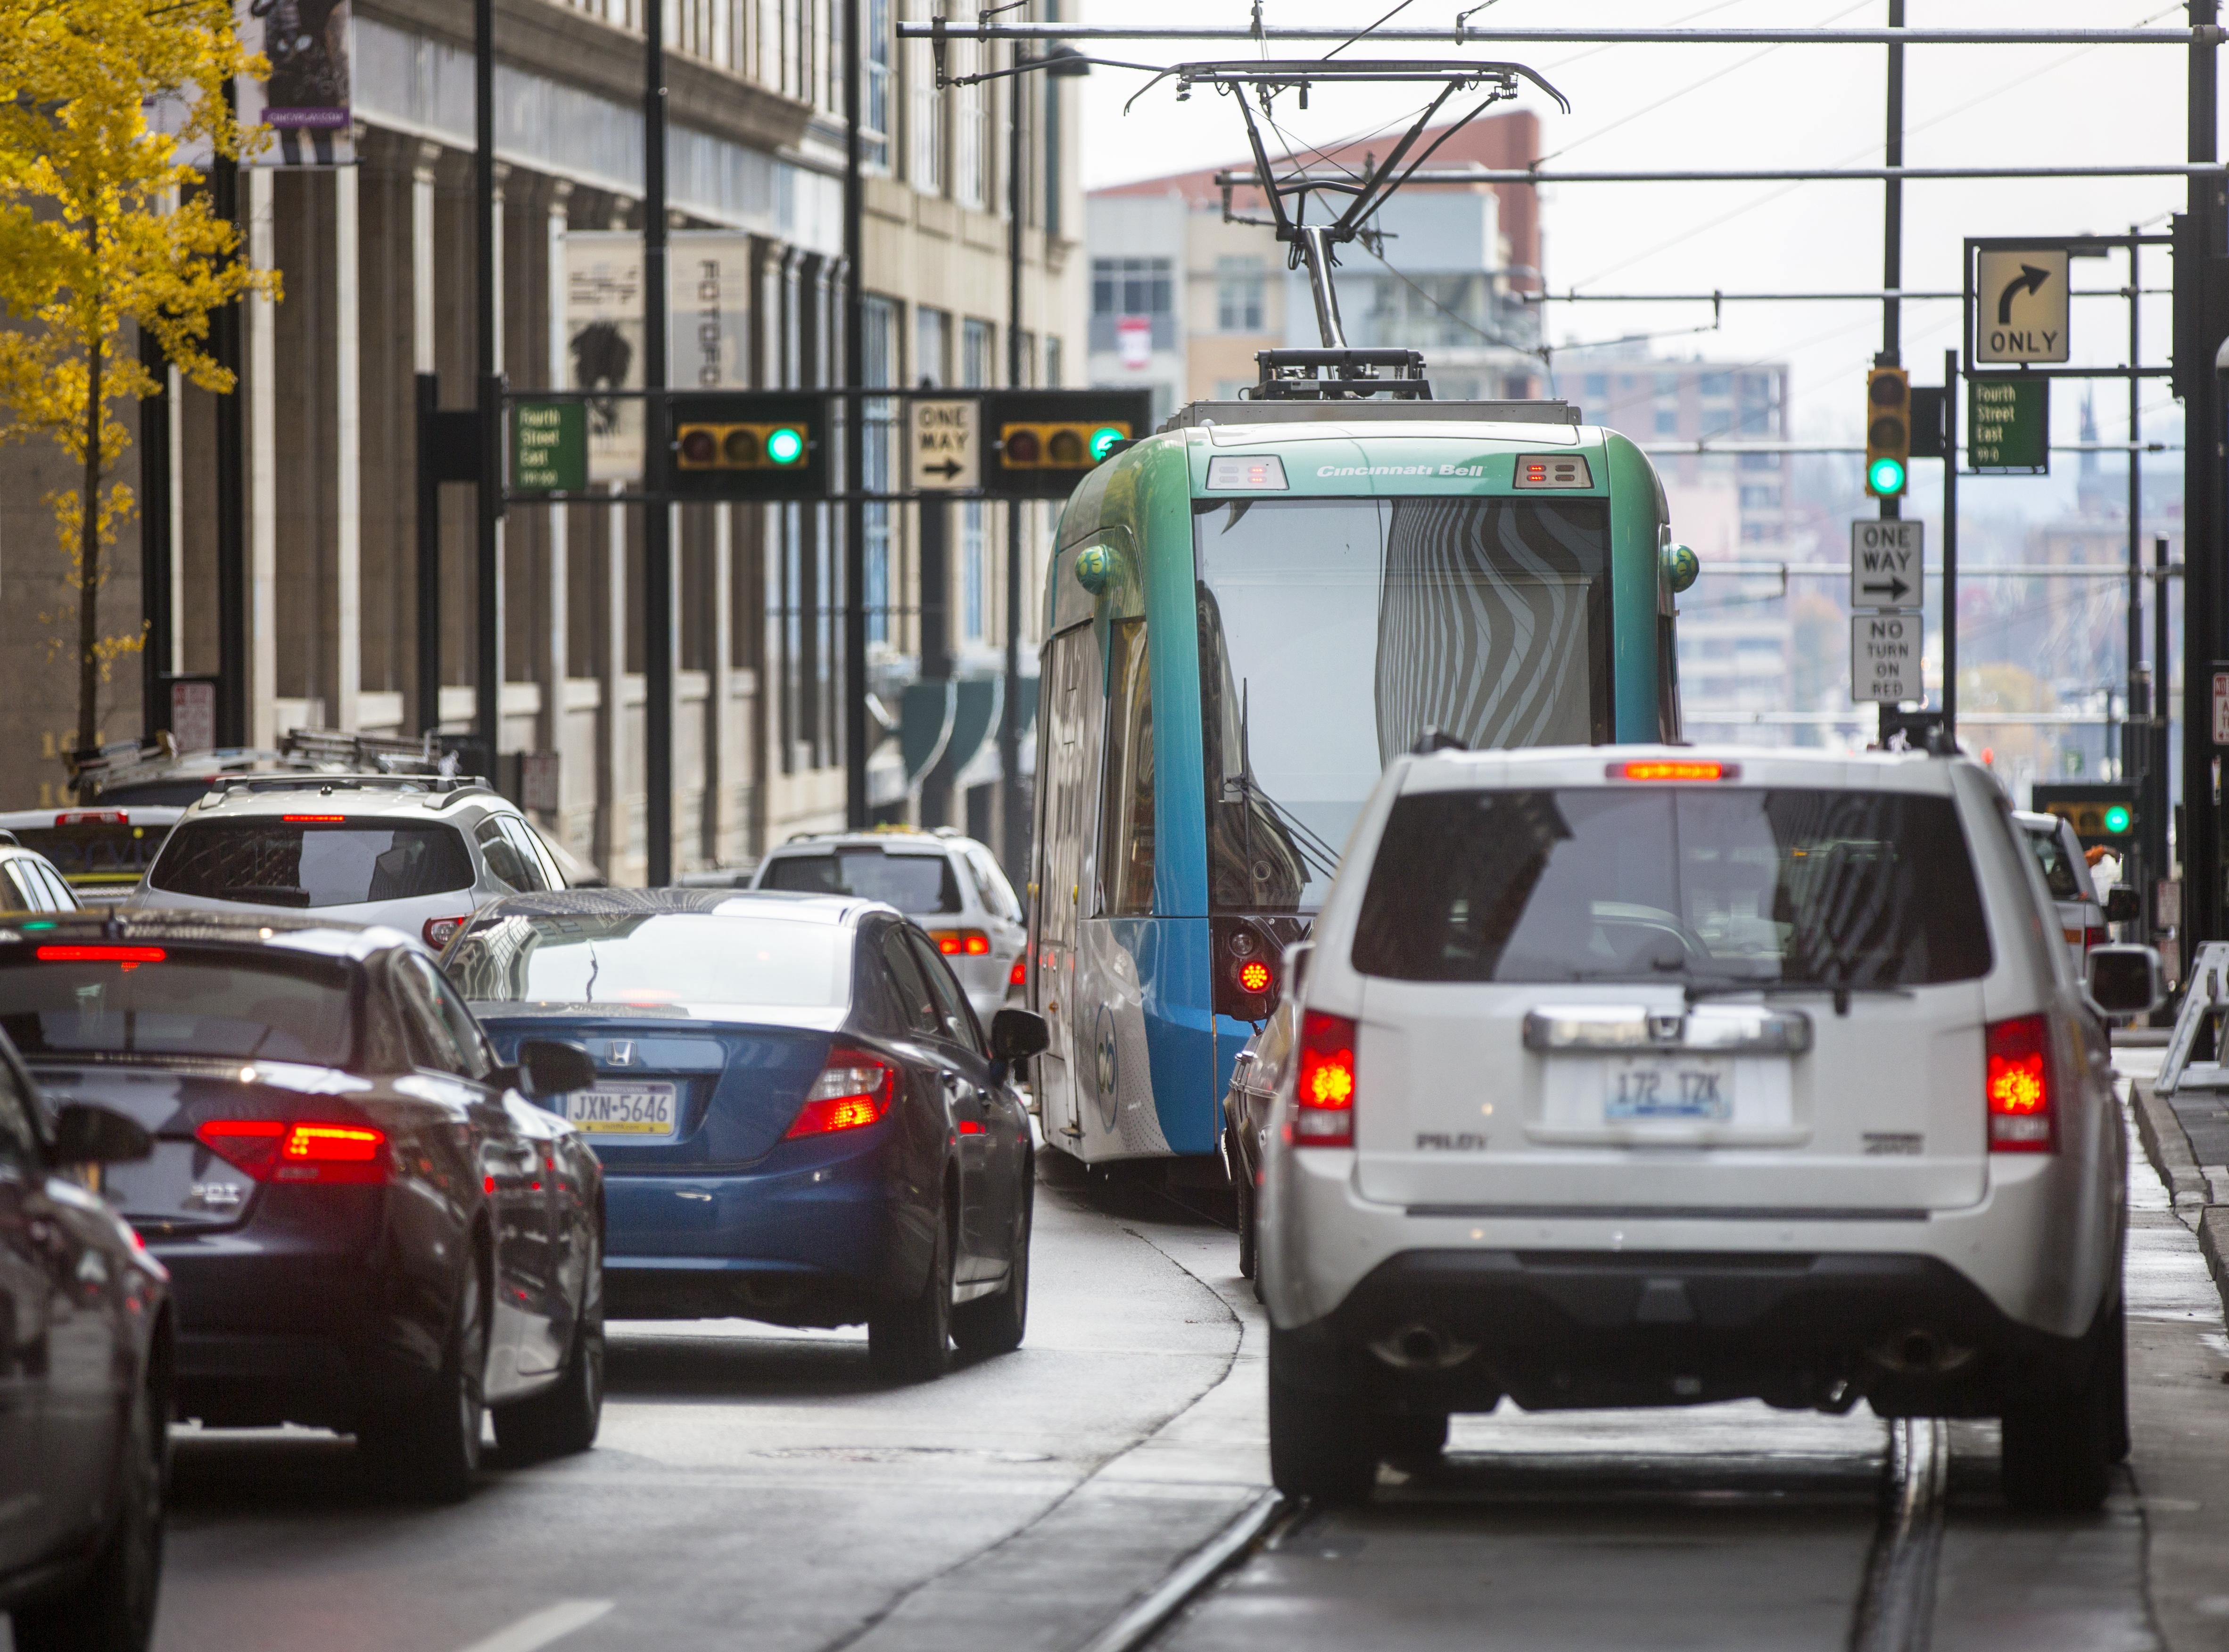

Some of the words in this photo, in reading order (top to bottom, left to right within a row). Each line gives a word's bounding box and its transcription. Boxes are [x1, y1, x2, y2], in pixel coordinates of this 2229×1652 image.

[1991, 331, 2058, 352] ONLY
[1976, 384, 2016, 402] Fourth
[520, 408, 561, 426] Fourth
[920, 406, 967, 427] ONE
[1976, 404, 2015, 422] Street
[520, 428, 560, 447] Street
[919, 431, 969, 452] WAY
[1976, 425, 2003, 443] East
[520, 448, 549, 467] East
[1316, 465, 1434, 477] Cincinnati
[1438, 464, 1484, 477] Bell
[1864, 526, 1911, 548] ONE
[1863, 549, 1912, 573] WAY
[1871, 619, 1903, 640] NO
[1866, 641, 1909, 659] TURN
[1876, 660, 1899, 678] ON
[1872, 680, 1903, 698] RED
